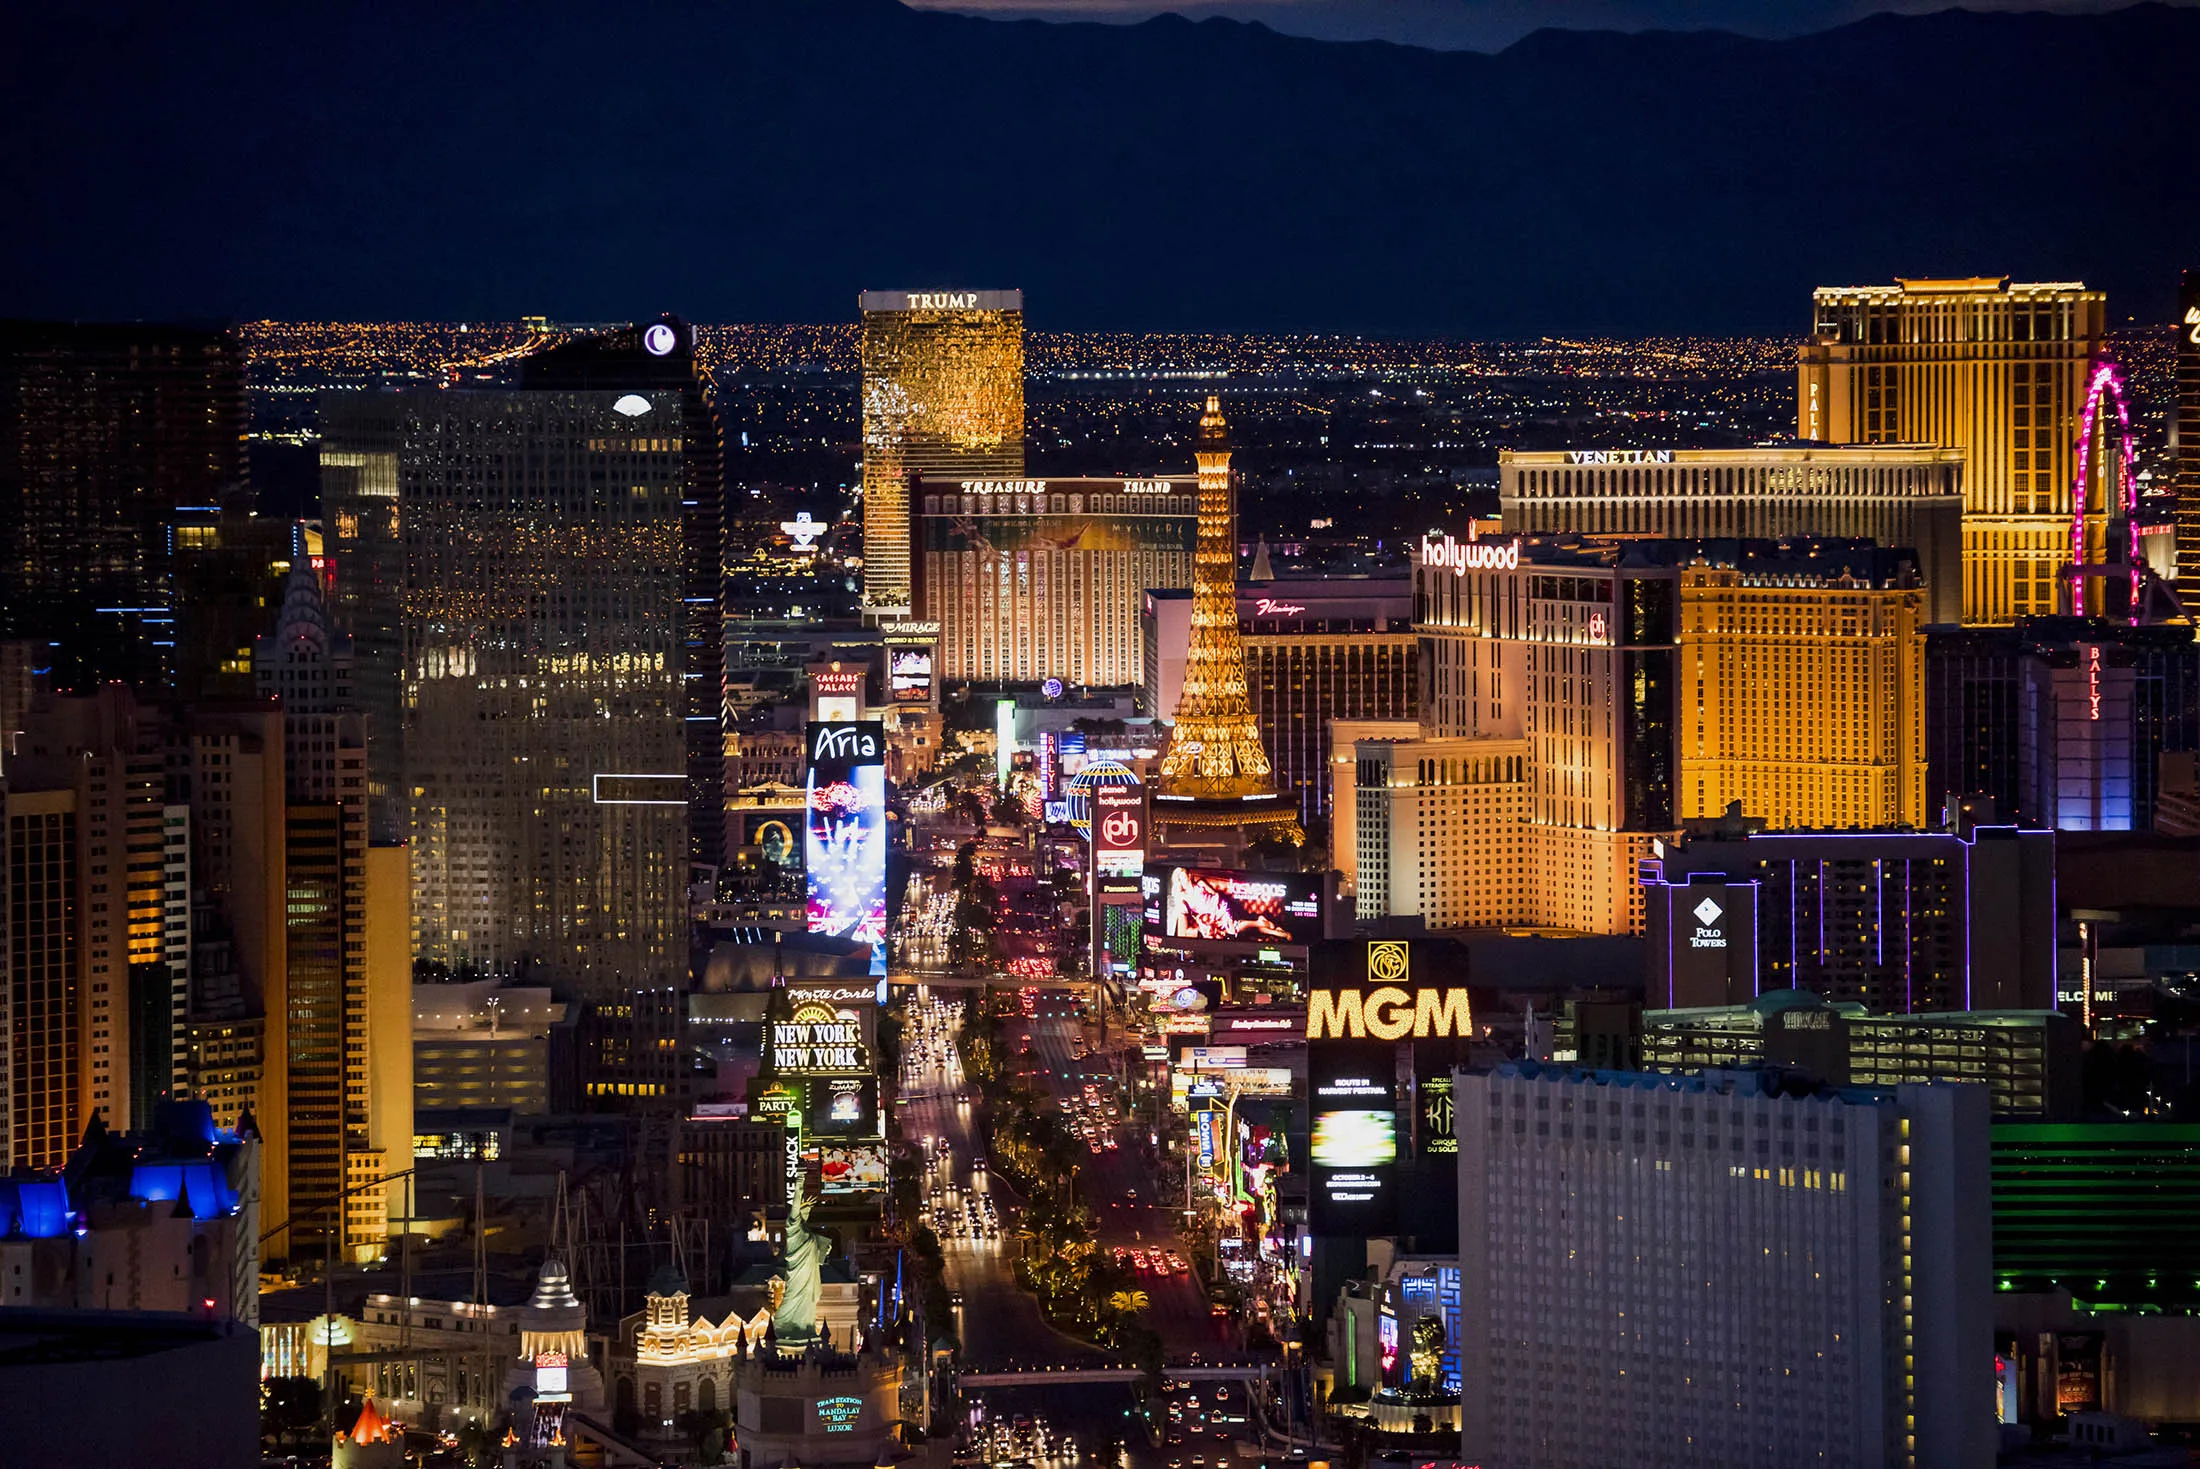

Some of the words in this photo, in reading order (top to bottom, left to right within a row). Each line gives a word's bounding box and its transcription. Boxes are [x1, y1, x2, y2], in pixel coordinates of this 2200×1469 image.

[907, 293, 978, 309] TRUMP
[1570, 450, 1671, 464] VENETIAN
[961, 481, 1046, 494] TREASURE
[1123, 481, 1171, 494] ISLAND
[1422, 534, 1518, 576] hollywood
[888, 622, 940, 633] MIRAGE
[816, 674, 858, 682] CAESARS
[818, 683, 857, 692] PALACE
[815, 726, 876, 761] Aria
[1098, 785, 1127, 795] planet
[1098, 797, 1142, 807] hollywood
[1107, 811, 1138, 841] ph
[1690, 937, 1727, 947] TOWERS
[833, 988, 876, 1000] Carlo
[1306, 986, 1472, 1039] MGM
[774, 1025, 811, 1044] NEW
[814, 1024, 857, 1043] YORK
[774, 1048, 811, 1067] NEW
[814, 1047, 858, 1066] YORK
[1200, 1113, 1211, 1151] ROSS
[786, 1136, 799, 1178] SHACK
[835, 1396, 862, 1405] STATION
[818, 1407, 860, 1416] MANDALAY
[827, 1424, 853, 1432] LUXOR
